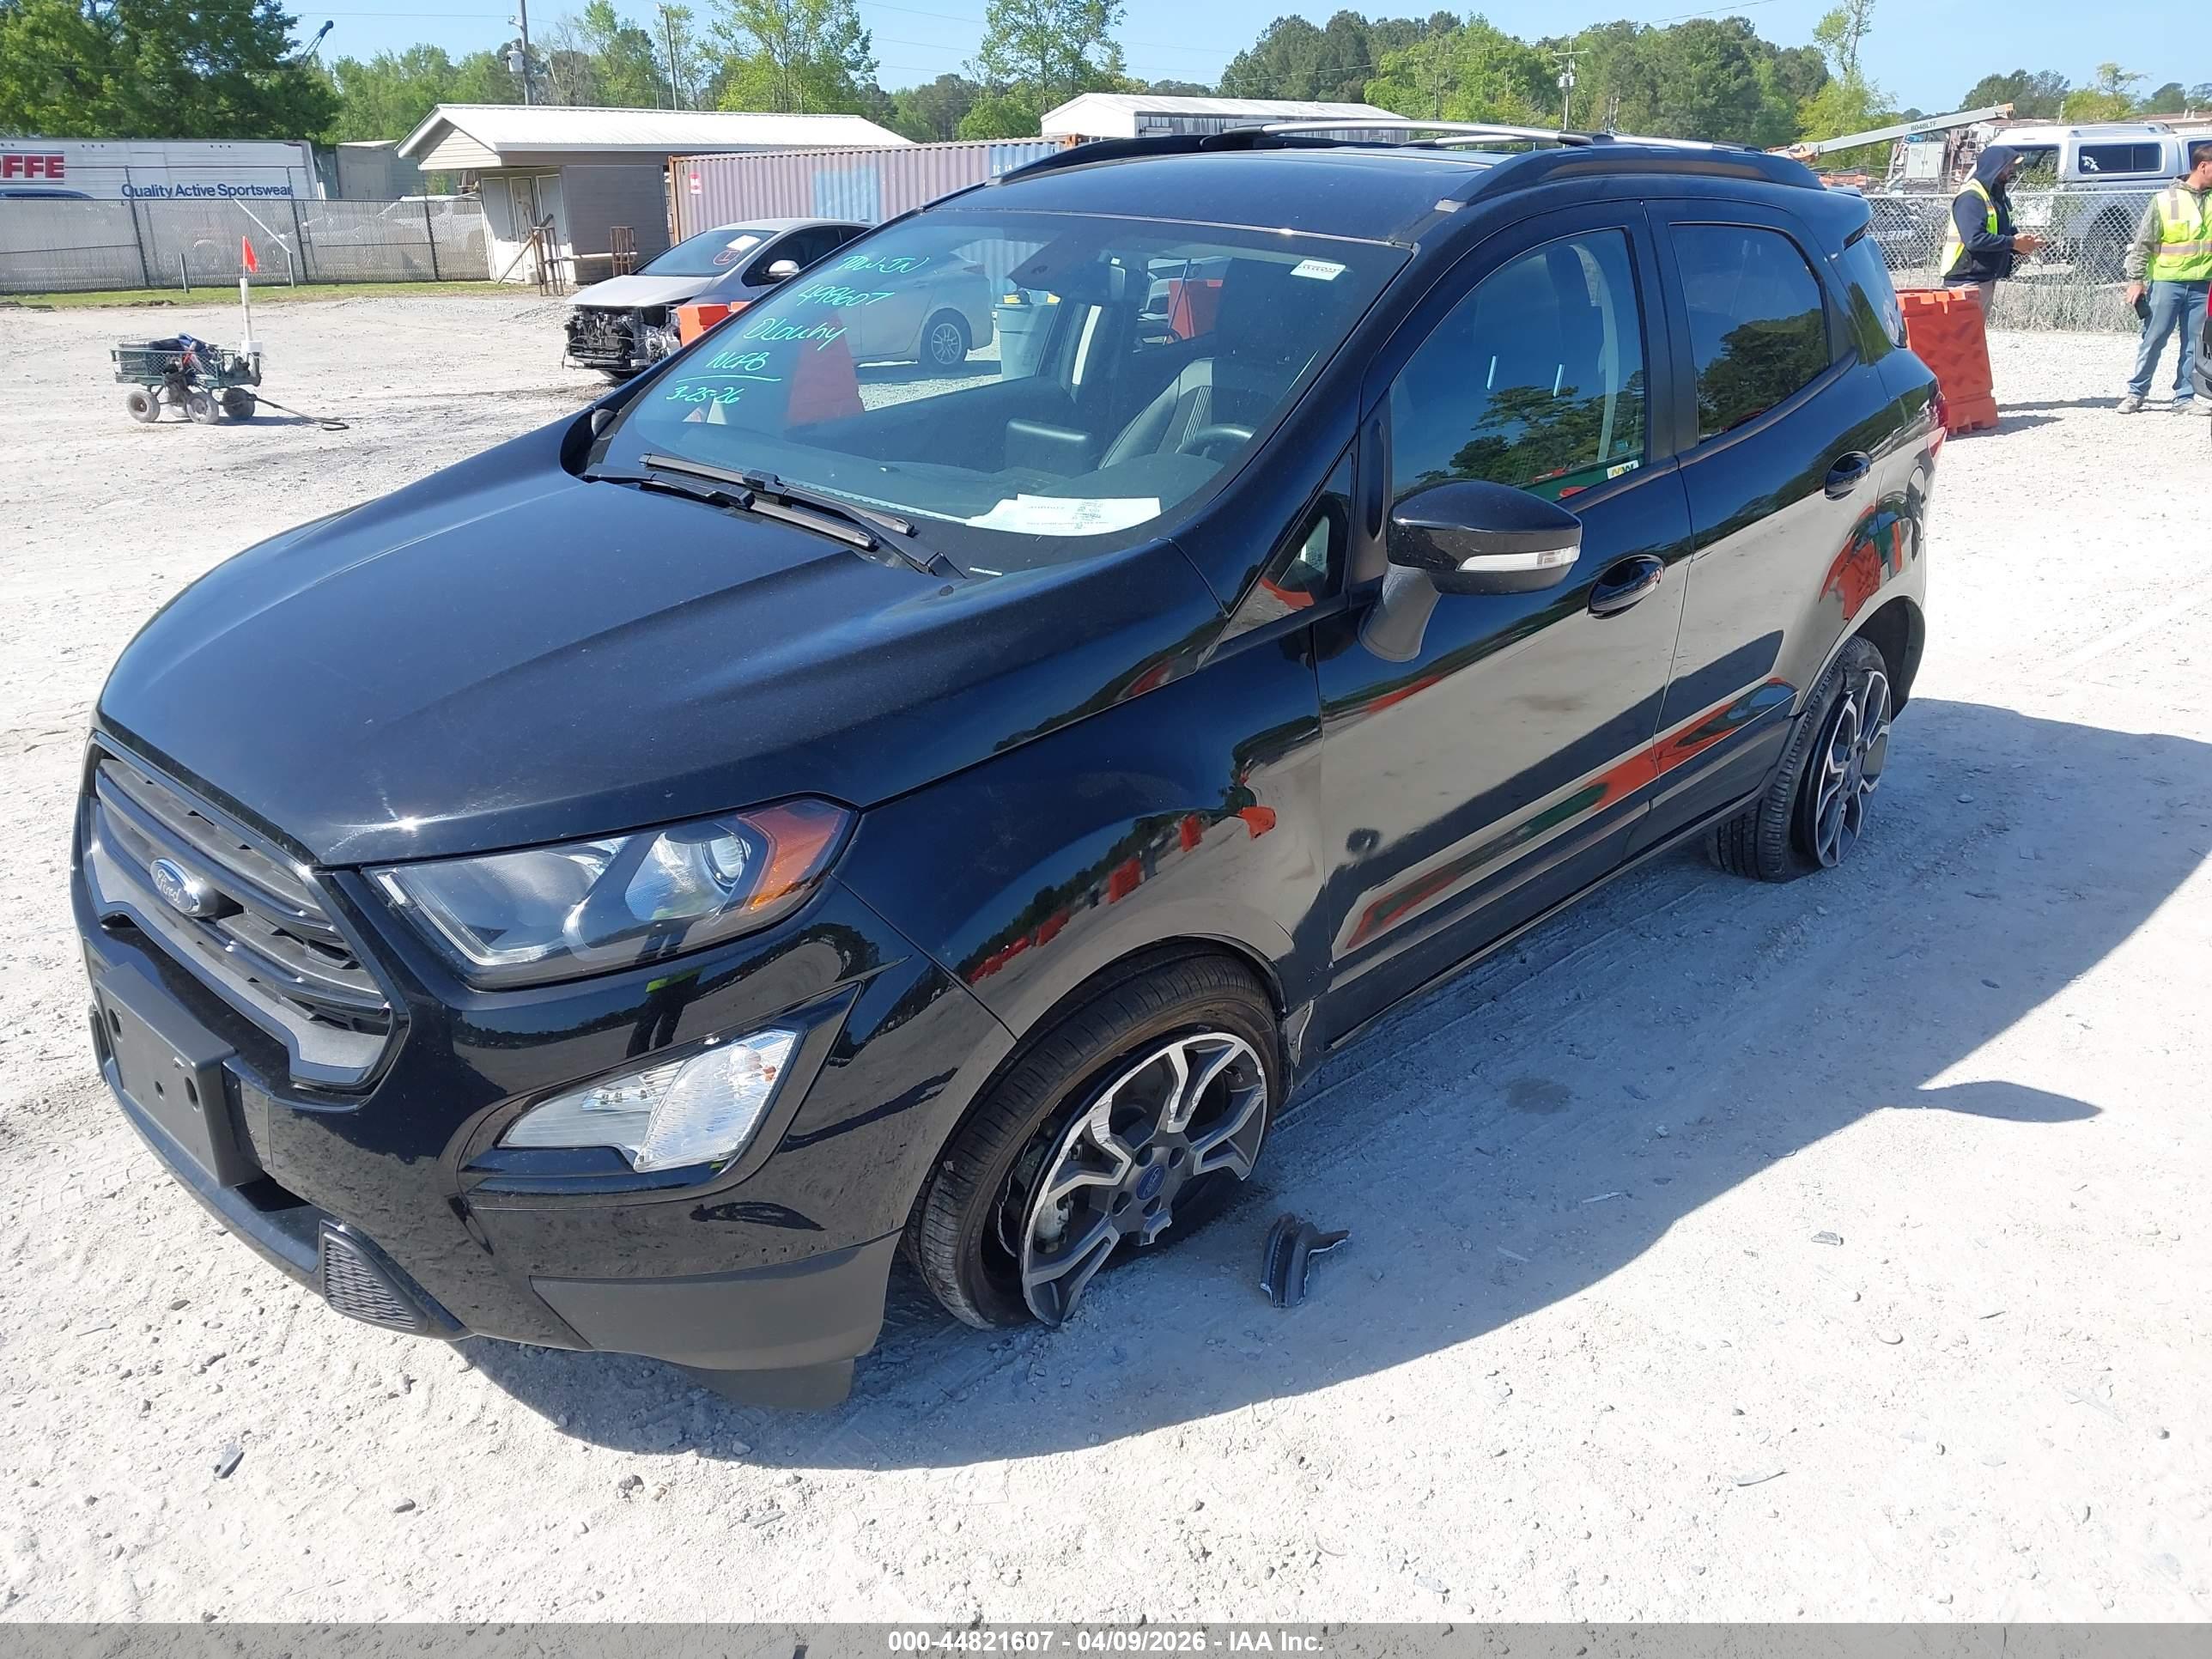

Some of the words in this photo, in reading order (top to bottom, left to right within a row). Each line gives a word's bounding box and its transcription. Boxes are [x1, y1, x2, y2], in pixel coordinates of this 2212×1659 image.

[0, 155, 64, 178] FFE
[121, 184, 173, 198] Quality
[175, 184, 216, 197] Active
[216, 183, 291, 198] Sportswear
[796, 283, 896, 307] 498607
[157, 867, 181, 904] Ford
